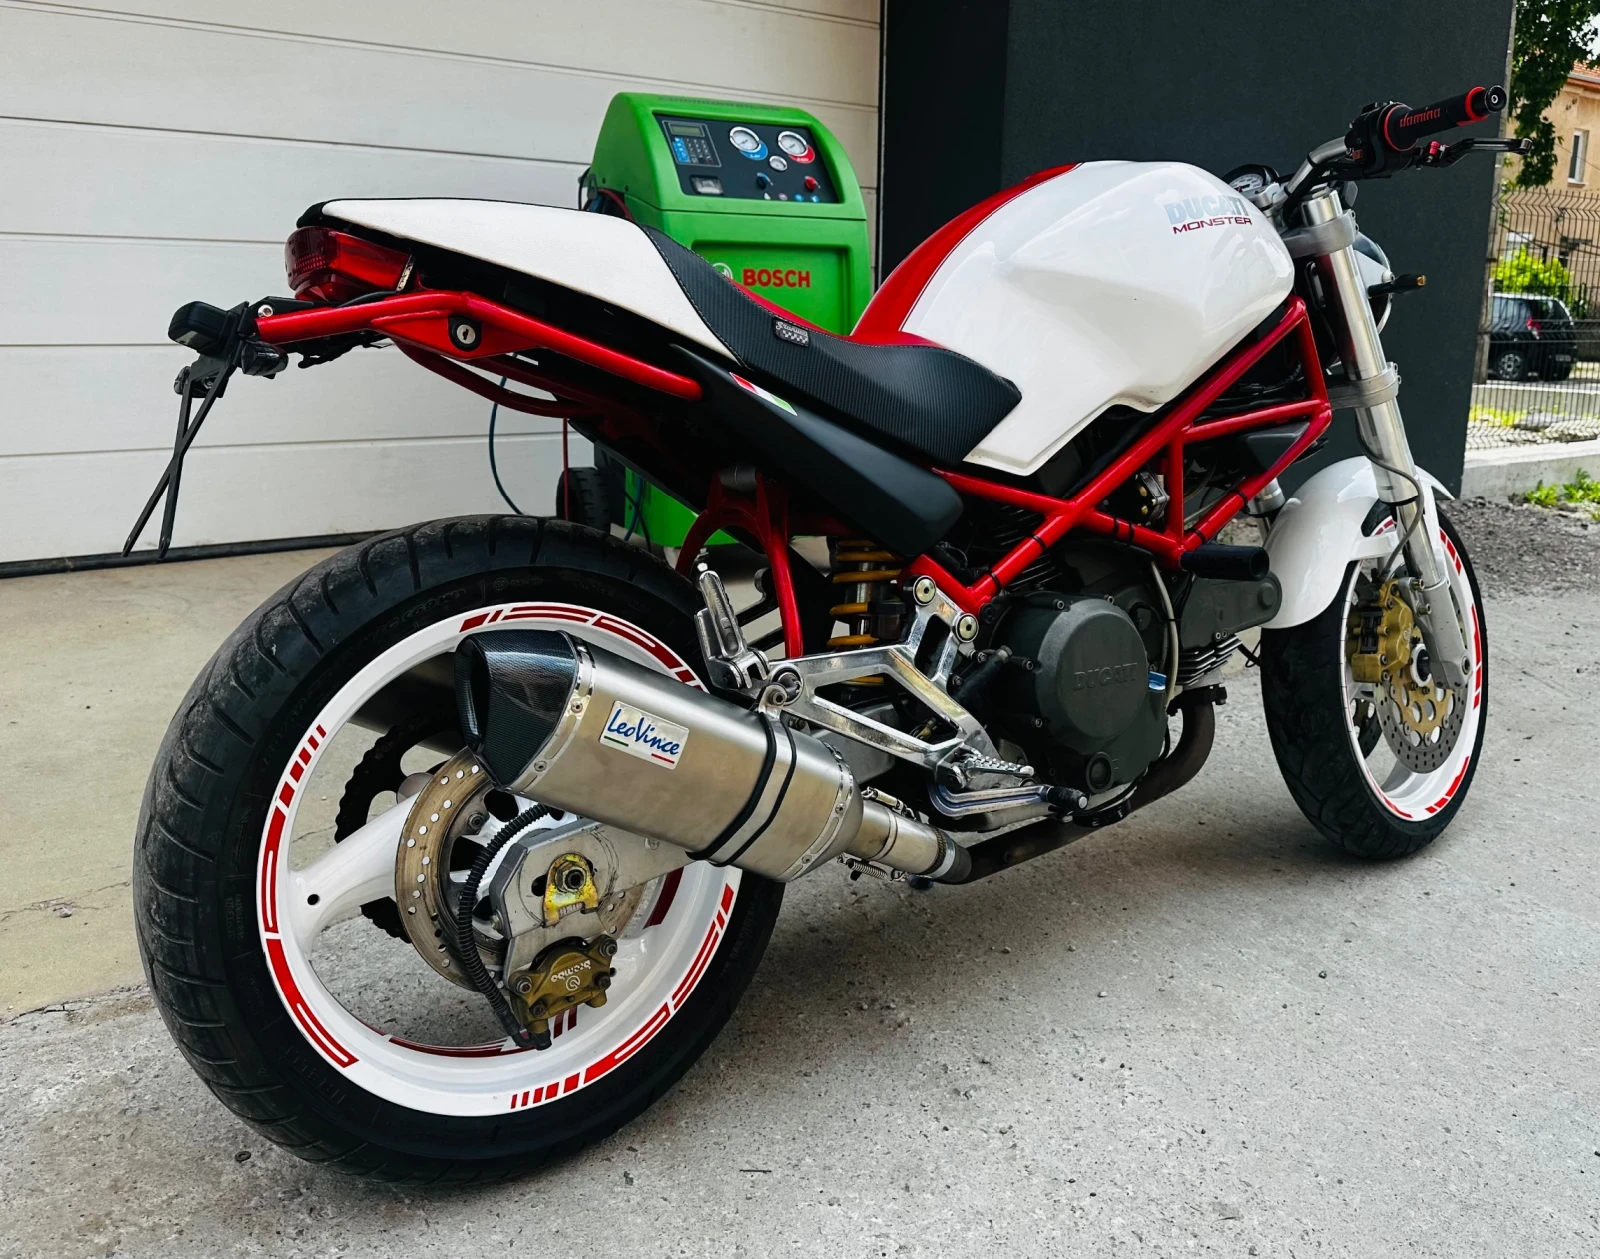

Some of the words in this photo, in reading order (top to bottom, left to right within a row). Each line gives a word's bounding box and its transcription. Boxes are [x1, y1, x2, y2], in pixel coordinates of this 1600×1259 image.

[1164, 194, 1249, 225] DUCATI
[1172, 216, 1253, 235] MONSTER
[743, 268, 811, 288] BOSCH
[1072, 662, 1138, 692] DUCATI
[607, 708, 681, 755] LeoVince
[550, 959, 592, 983] brembo
